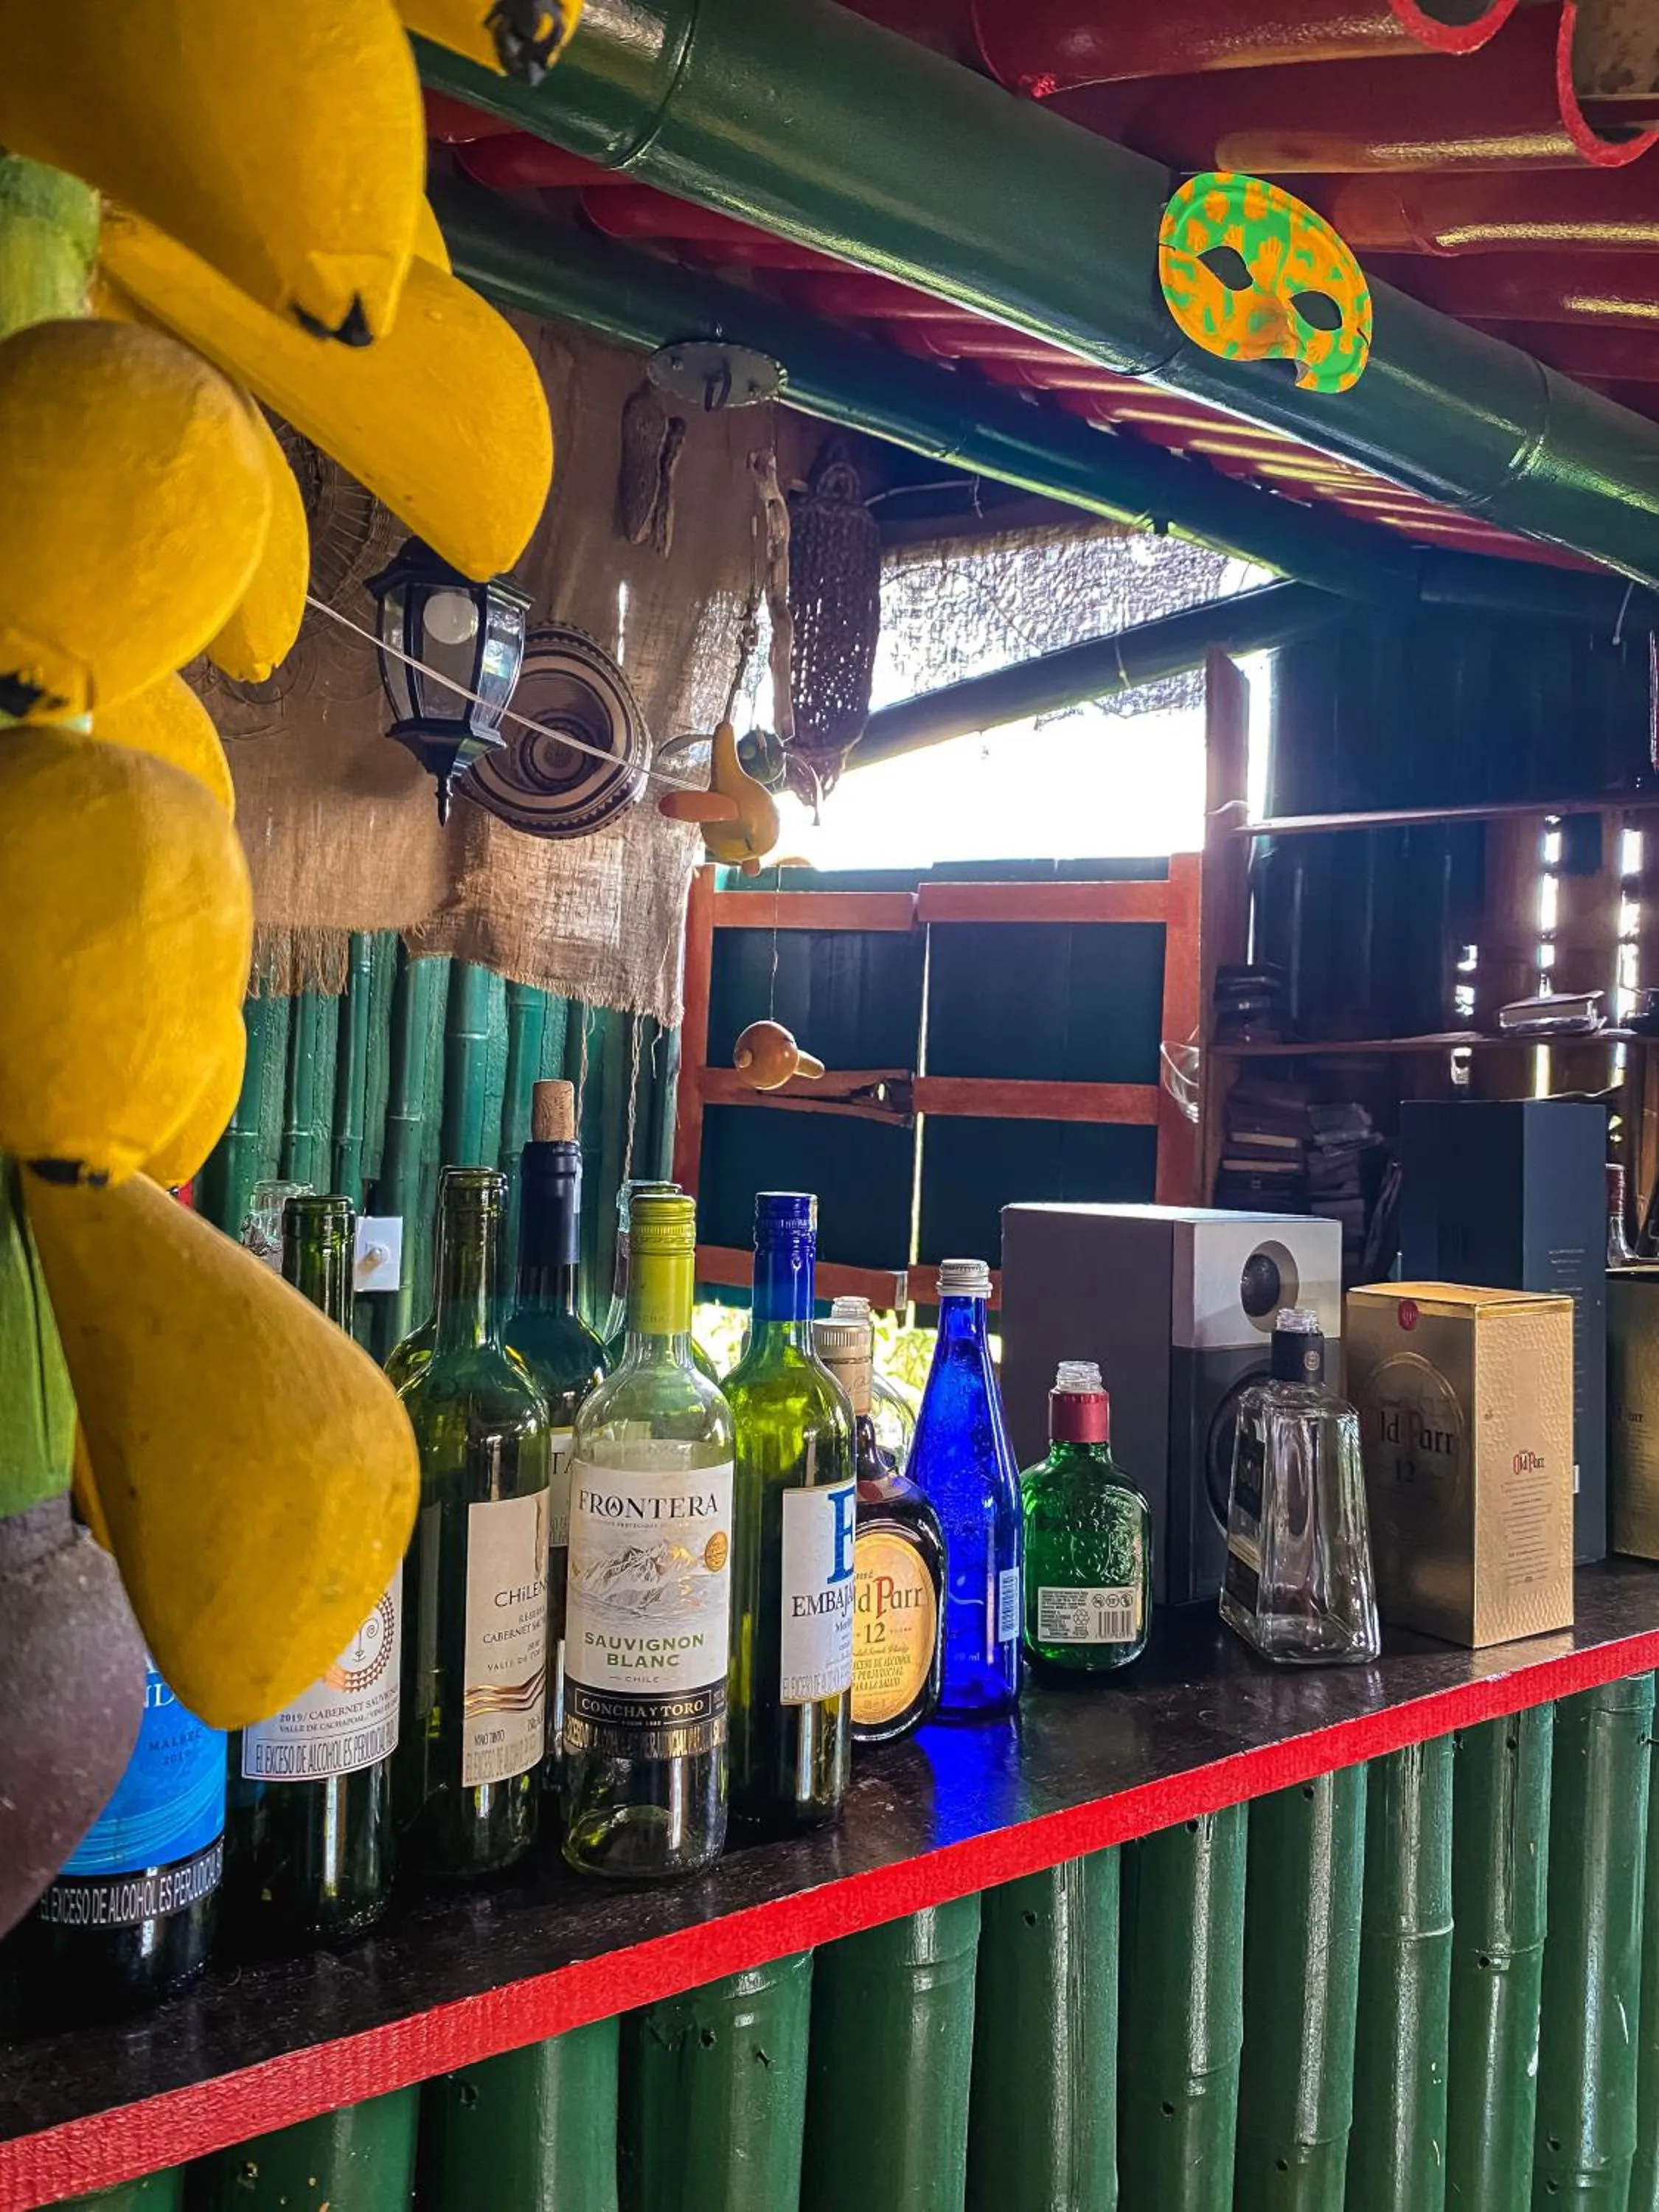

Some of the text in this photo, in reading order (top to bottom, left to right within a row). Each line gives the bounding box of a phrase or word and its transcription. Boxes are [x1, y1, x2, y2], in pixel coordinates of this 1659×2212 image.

[578, 1489, 719, 1520] FRONTERA
[854, 1575, 924, 1620] ld Parr
[483, 1622, 532, 1644] CABERNET
[584, 1631, 705, 1652] SAUVIGNON
[863, 1621, 886, 1644] 12
[606, 1652, 680, 1669] BLANC
[309, 1701, 364, 1721] CABERNET
[581, 1698, 647, 1718] CONCHA
[649, 1706, 658, 1717] Y
[659, 1699, 704, 1717] TORO
[148, 1724, 204, 1752] MALBEC
[255, 1744, 264, 1774] EL
[265, 1744, 295, 1774] EXCESO
[296, 1744, 307, 1773] DE
[308, 1739, 343, 1773] ALCOHOL
[51, 1888, 89, 1924] EXCESO
[91, 1888, 108, 1924] DE
[109, 1881, 158, 1923] ALCOHOL
[159, 1874, 173, 1913] ES
